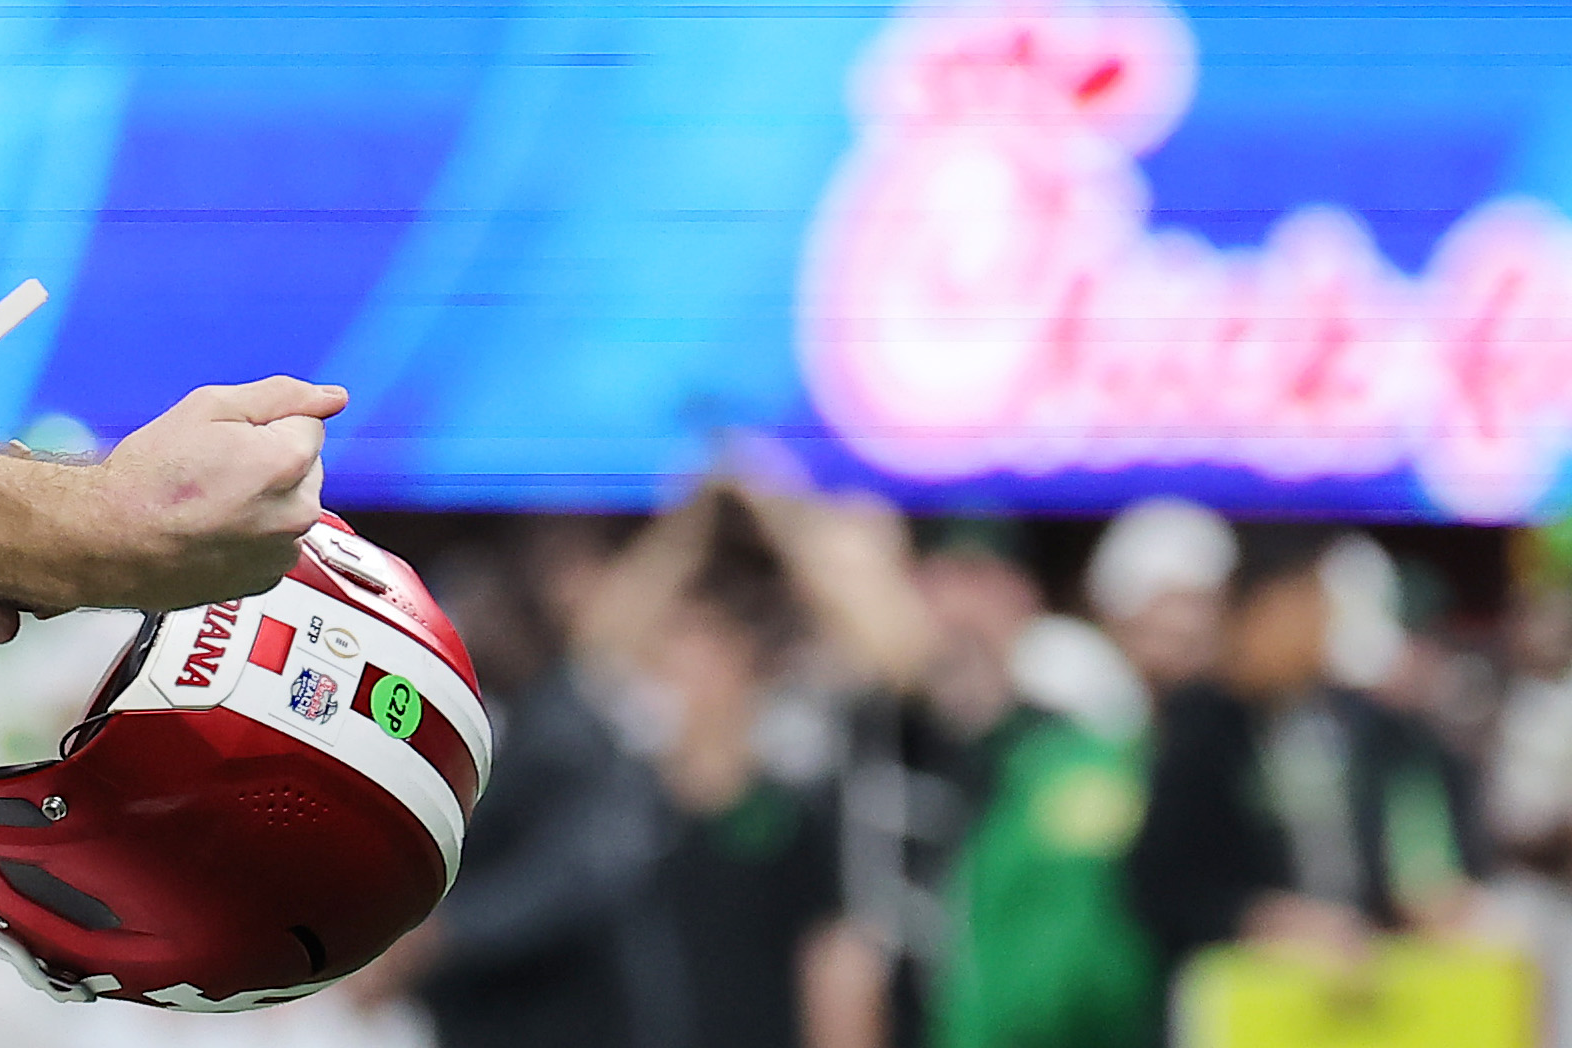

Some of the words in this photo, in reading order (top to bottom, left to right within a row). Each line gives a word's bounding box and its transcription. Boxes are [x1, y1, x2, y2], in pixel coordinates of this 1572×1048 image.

[307, 615, 324, 644] CFP
[294, 669, 321, 715] PEACH
[385, 683, 411, 733] C2P
